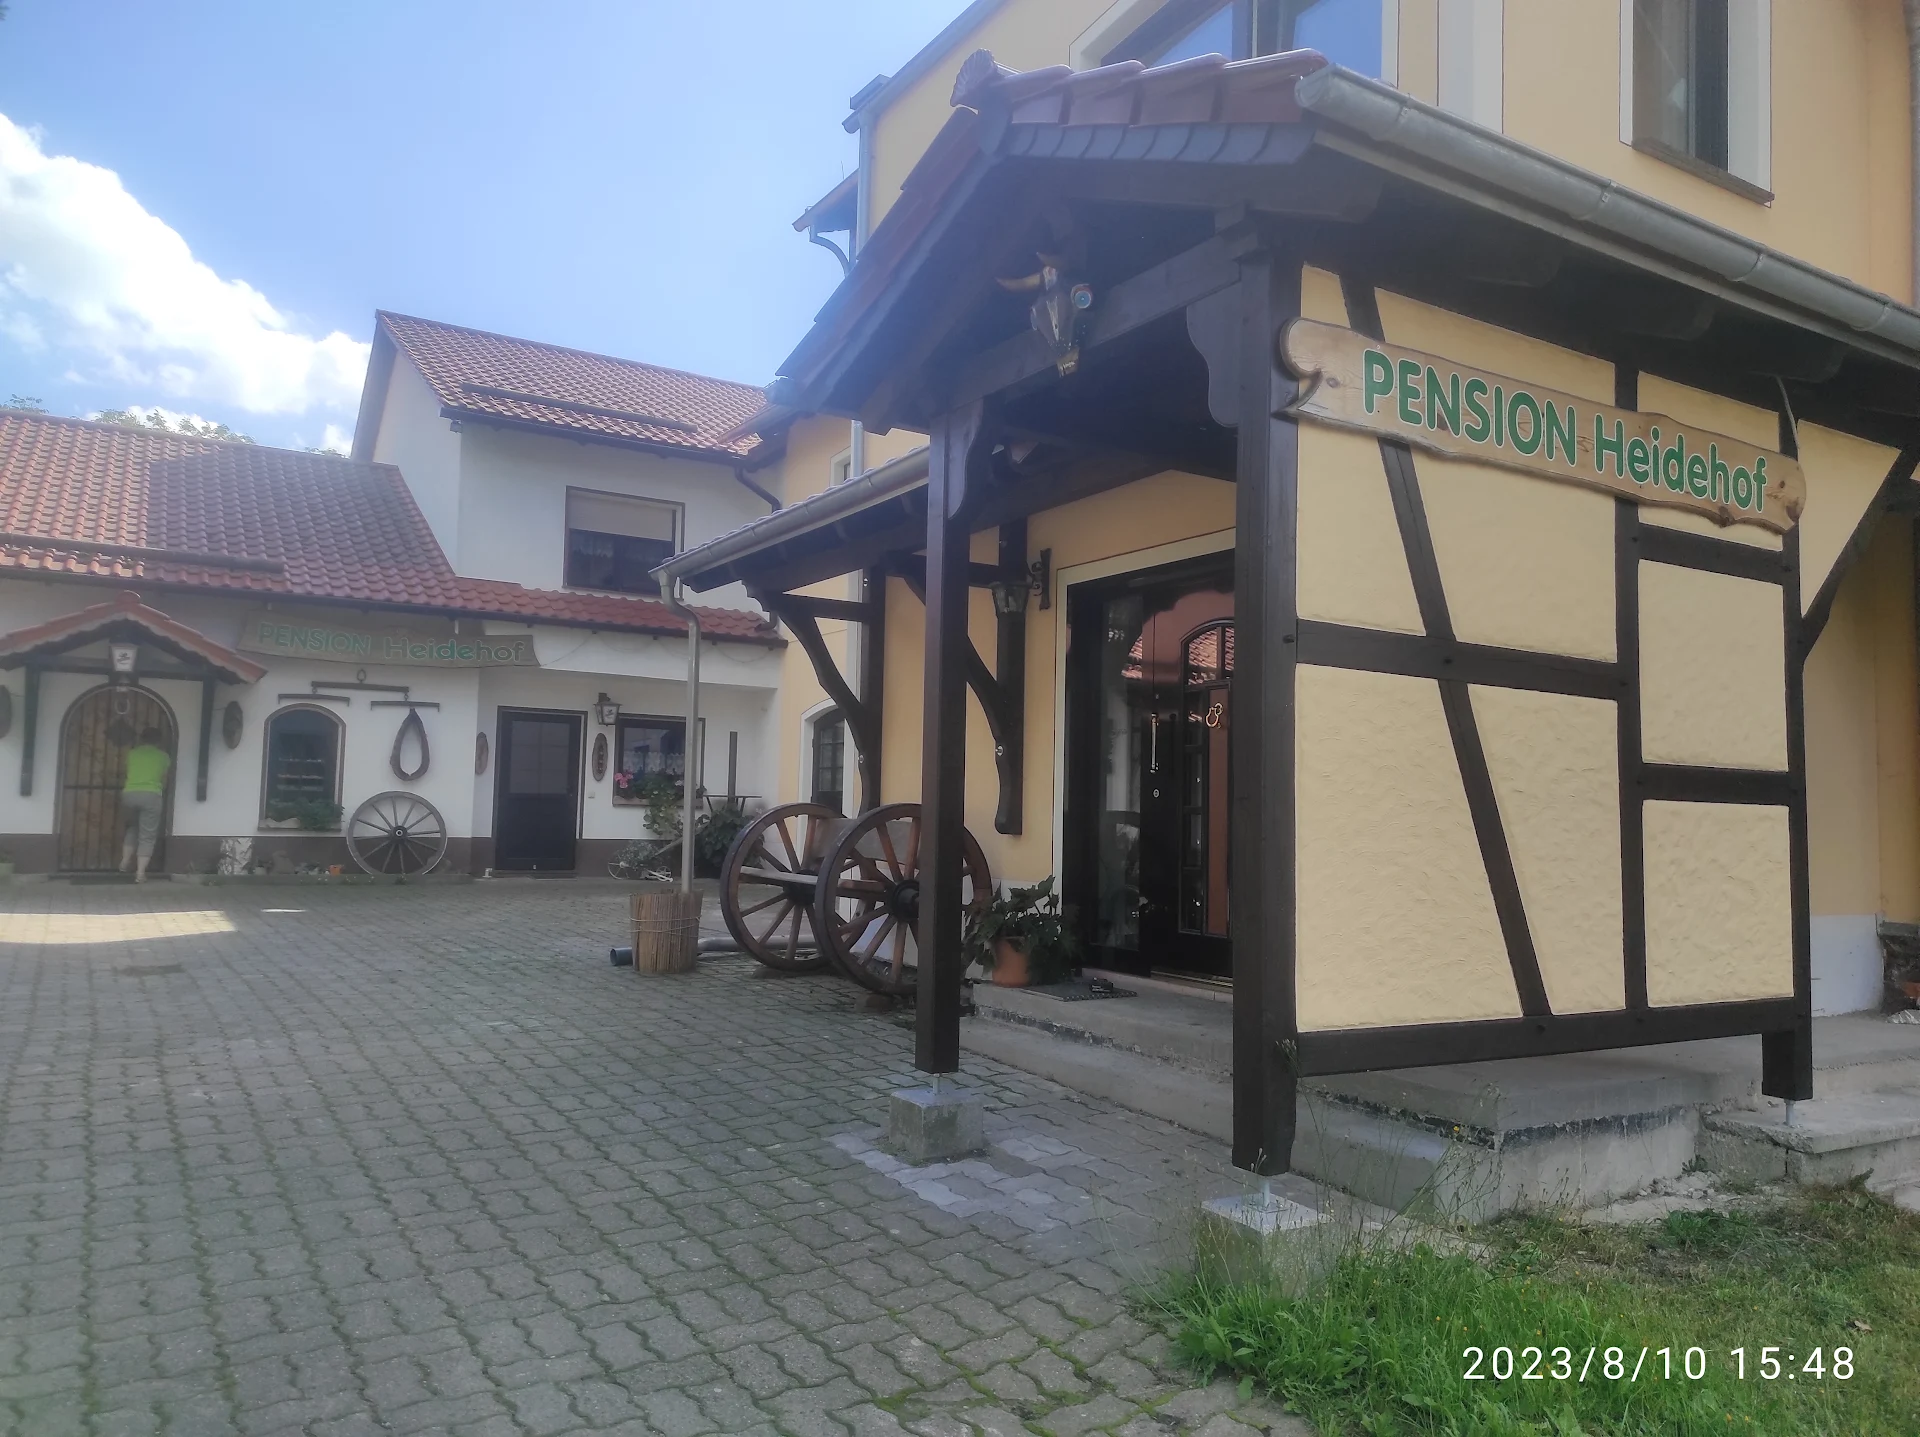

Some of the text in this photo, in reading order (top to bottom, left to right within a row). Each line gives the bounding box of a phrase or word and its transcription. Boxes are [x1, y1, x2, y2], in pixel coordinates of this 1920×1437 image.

[1363, 348, 1767, 512] PENSION Heidehof
[257, 622, 525, 661] PENSION Heidehof
